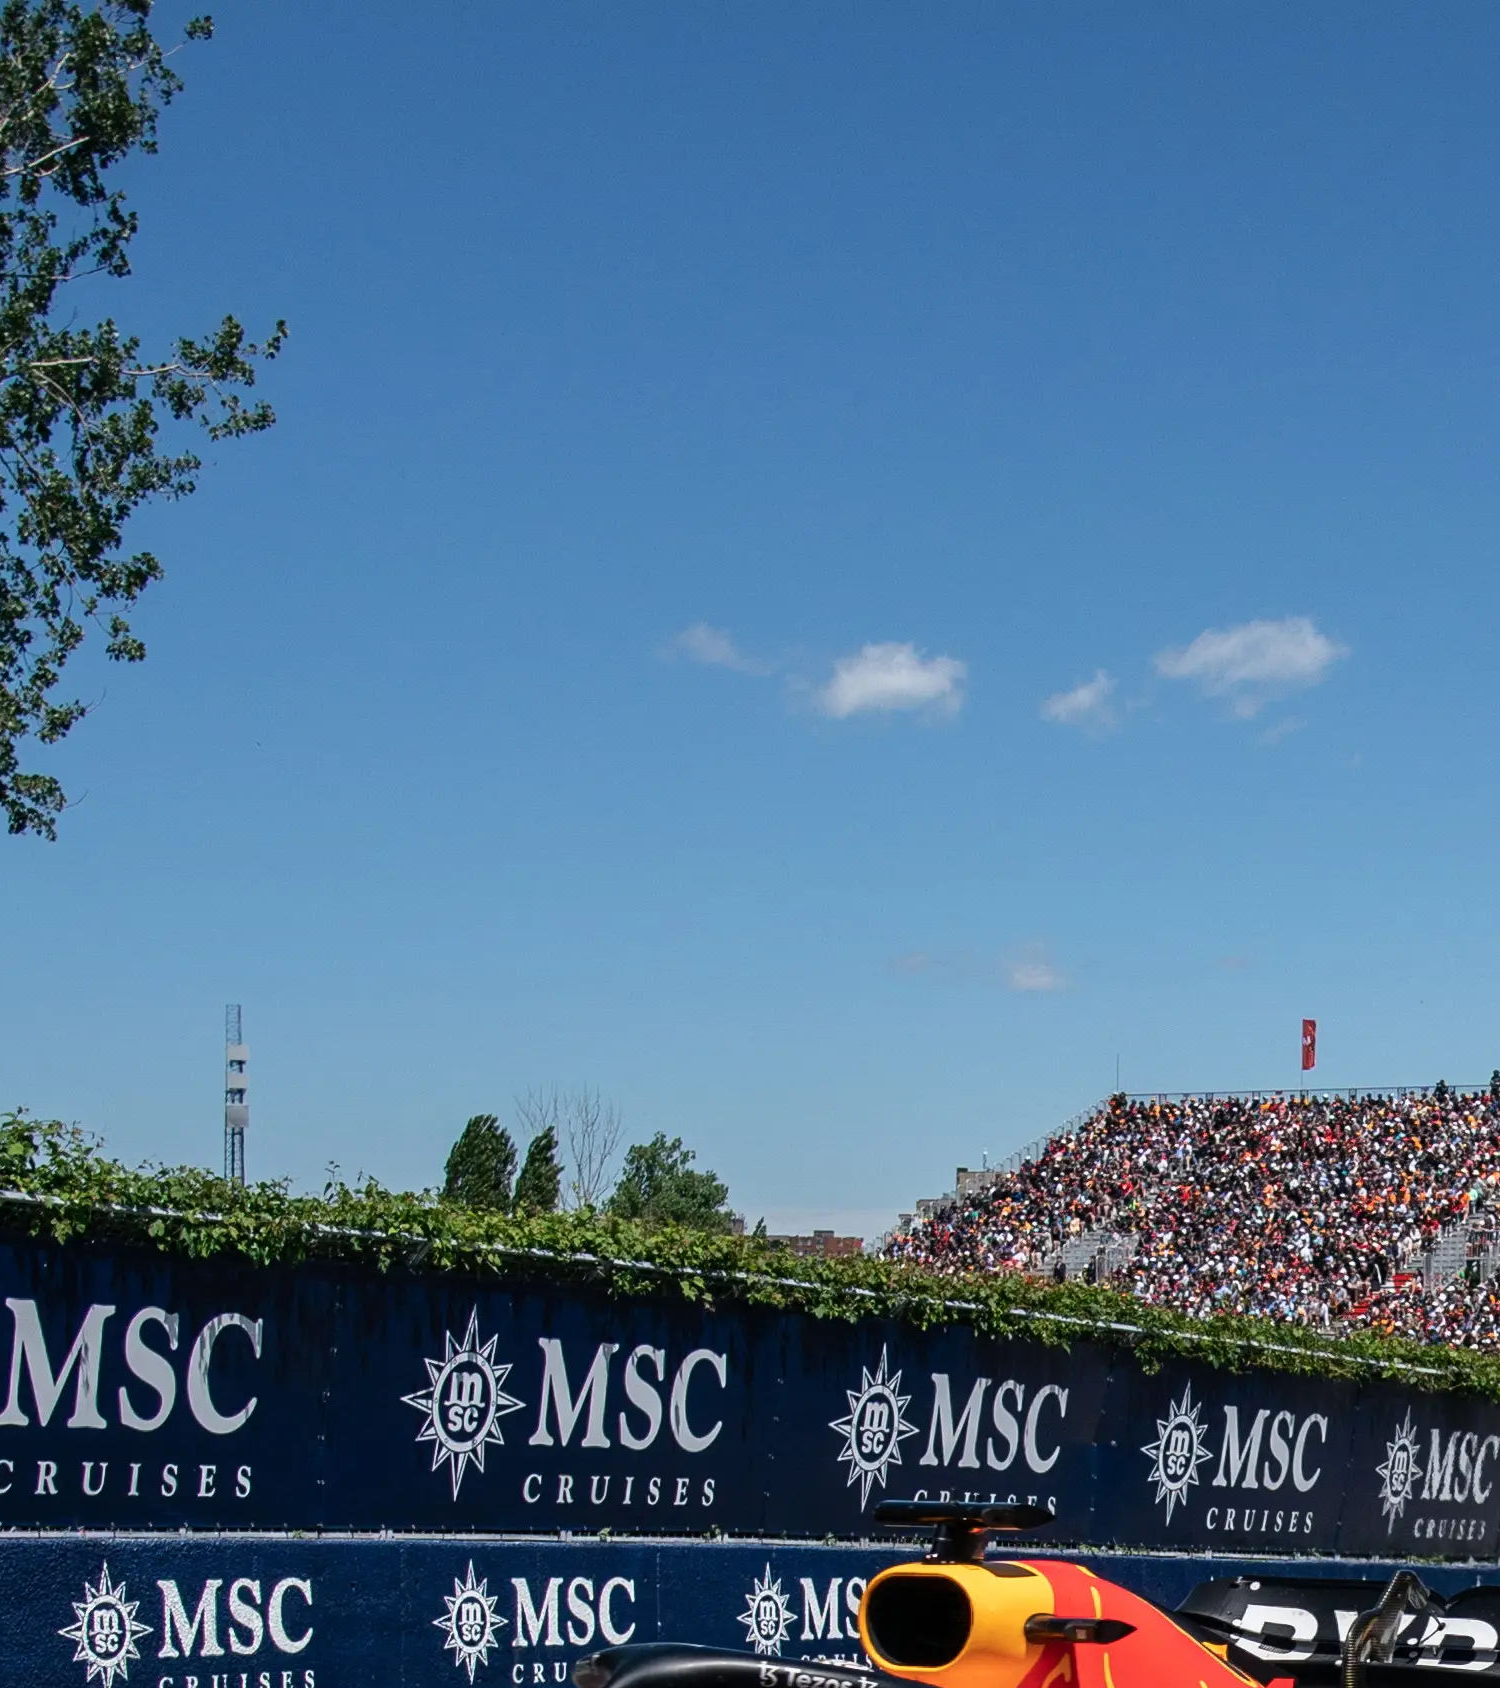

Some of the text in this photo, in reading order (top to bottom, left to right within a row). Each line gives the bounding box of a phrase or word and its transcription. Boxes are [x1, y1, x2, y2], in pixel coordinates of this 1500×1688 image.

[528, 1337, 727, 1453] MSC
[919, 1372, 1069, 1474] MSC
[1211, 1404, 1329, 1493] MSC
[1420, 1428, 1500, 1505] MSC
[522, 1473, 716, 1507] CRUISES
[1205, 1506, 1314, 1534] CRUISES
[1413, 1518, 1486, 1541] CRUISES
[156, 1576, 314, 1659] MSC
[510, 1576, 636, 1647] MSC
